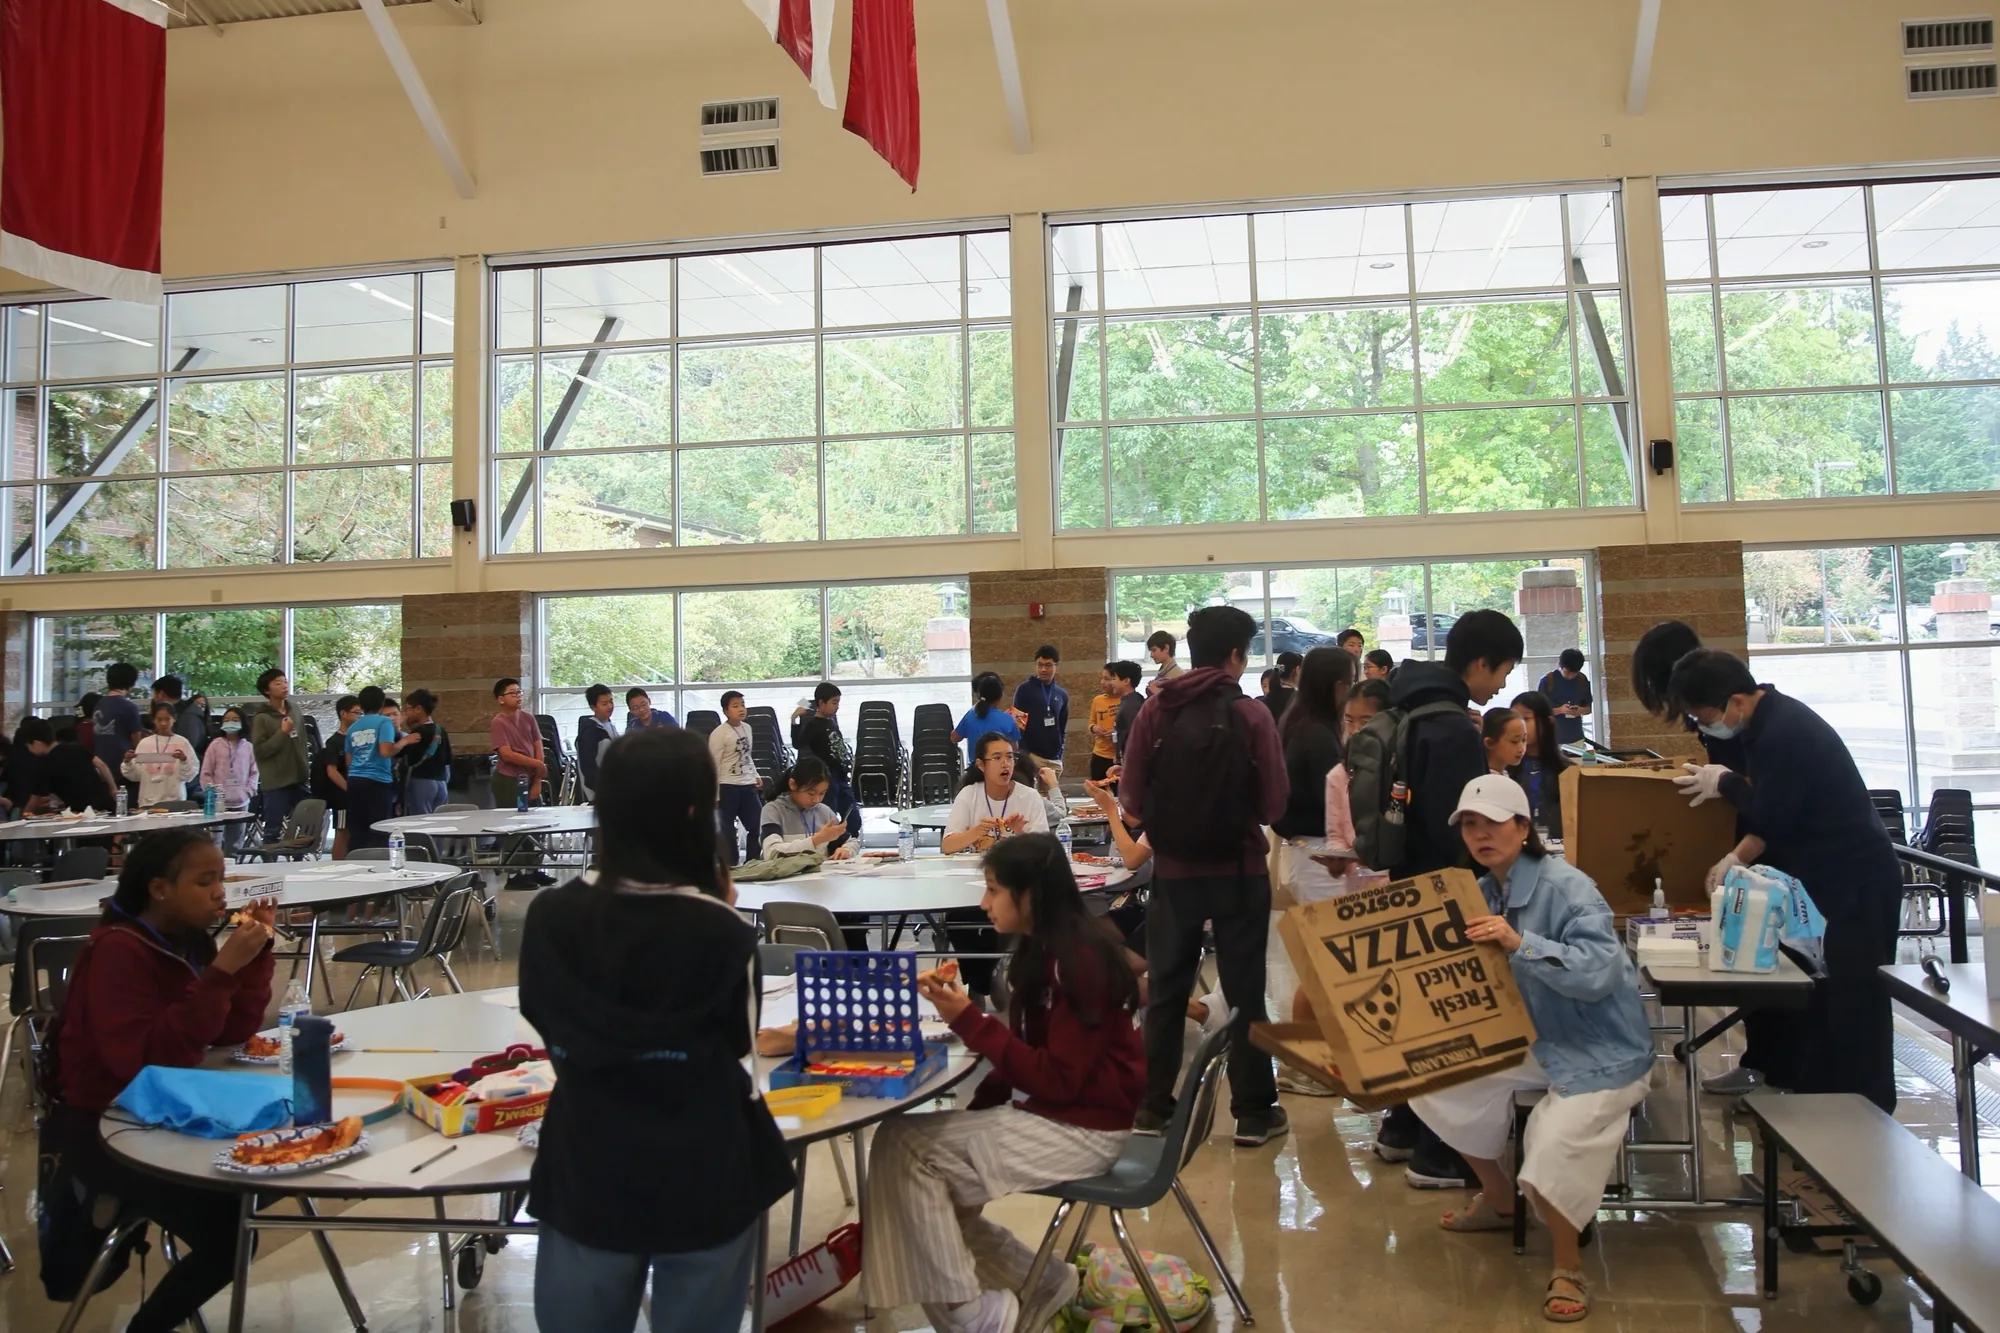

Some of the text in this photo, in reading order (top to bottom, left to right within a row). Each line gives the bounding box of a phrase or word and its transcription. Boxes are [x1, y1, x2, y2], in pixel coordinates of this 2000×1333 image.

[1333, 887, 1385, 907] FOOD COURT
[1336, 888, 1421, 921] COSTCO
[1324, 899, 1476, 974] PIZZA
[1411, 1046, 1478, 1075] KIRKLAND
